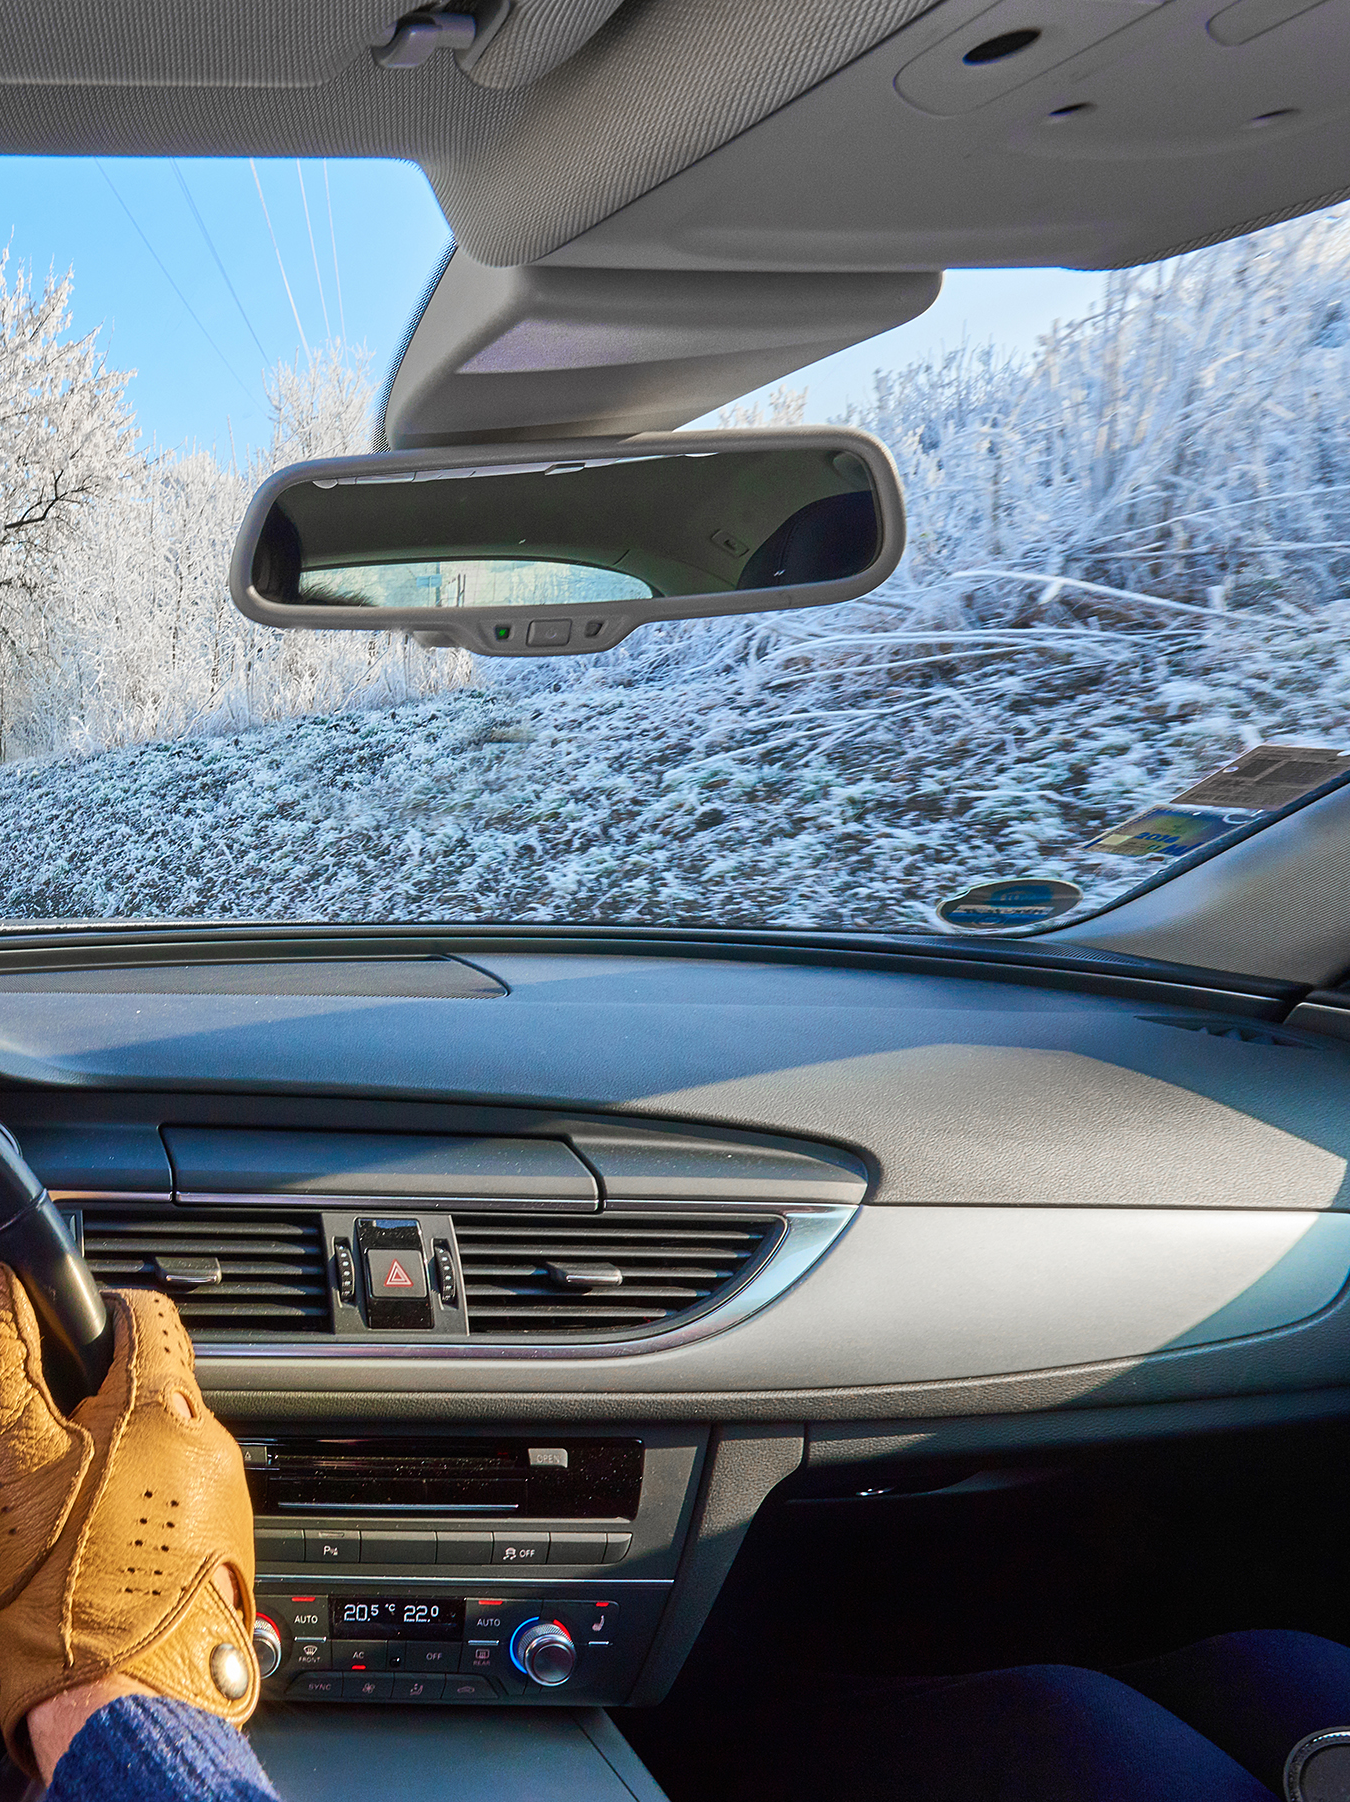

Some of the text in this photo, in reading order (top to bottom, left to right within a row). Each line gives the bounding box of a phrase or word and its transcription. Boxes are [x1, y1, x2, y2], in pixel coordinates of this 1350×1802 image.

[536, 1454, 561, 1464] OPEN
[519, 1549, 535, 1559] OFF
[294, 1615, 318, 1624] AUTO
[476, 1618, 501, 1627] AUTO
[353, 1651, 365, 1659] AC
[426, 1652, 442, 1661] OFF
[308, 1683, 332, 1691] SYNC
